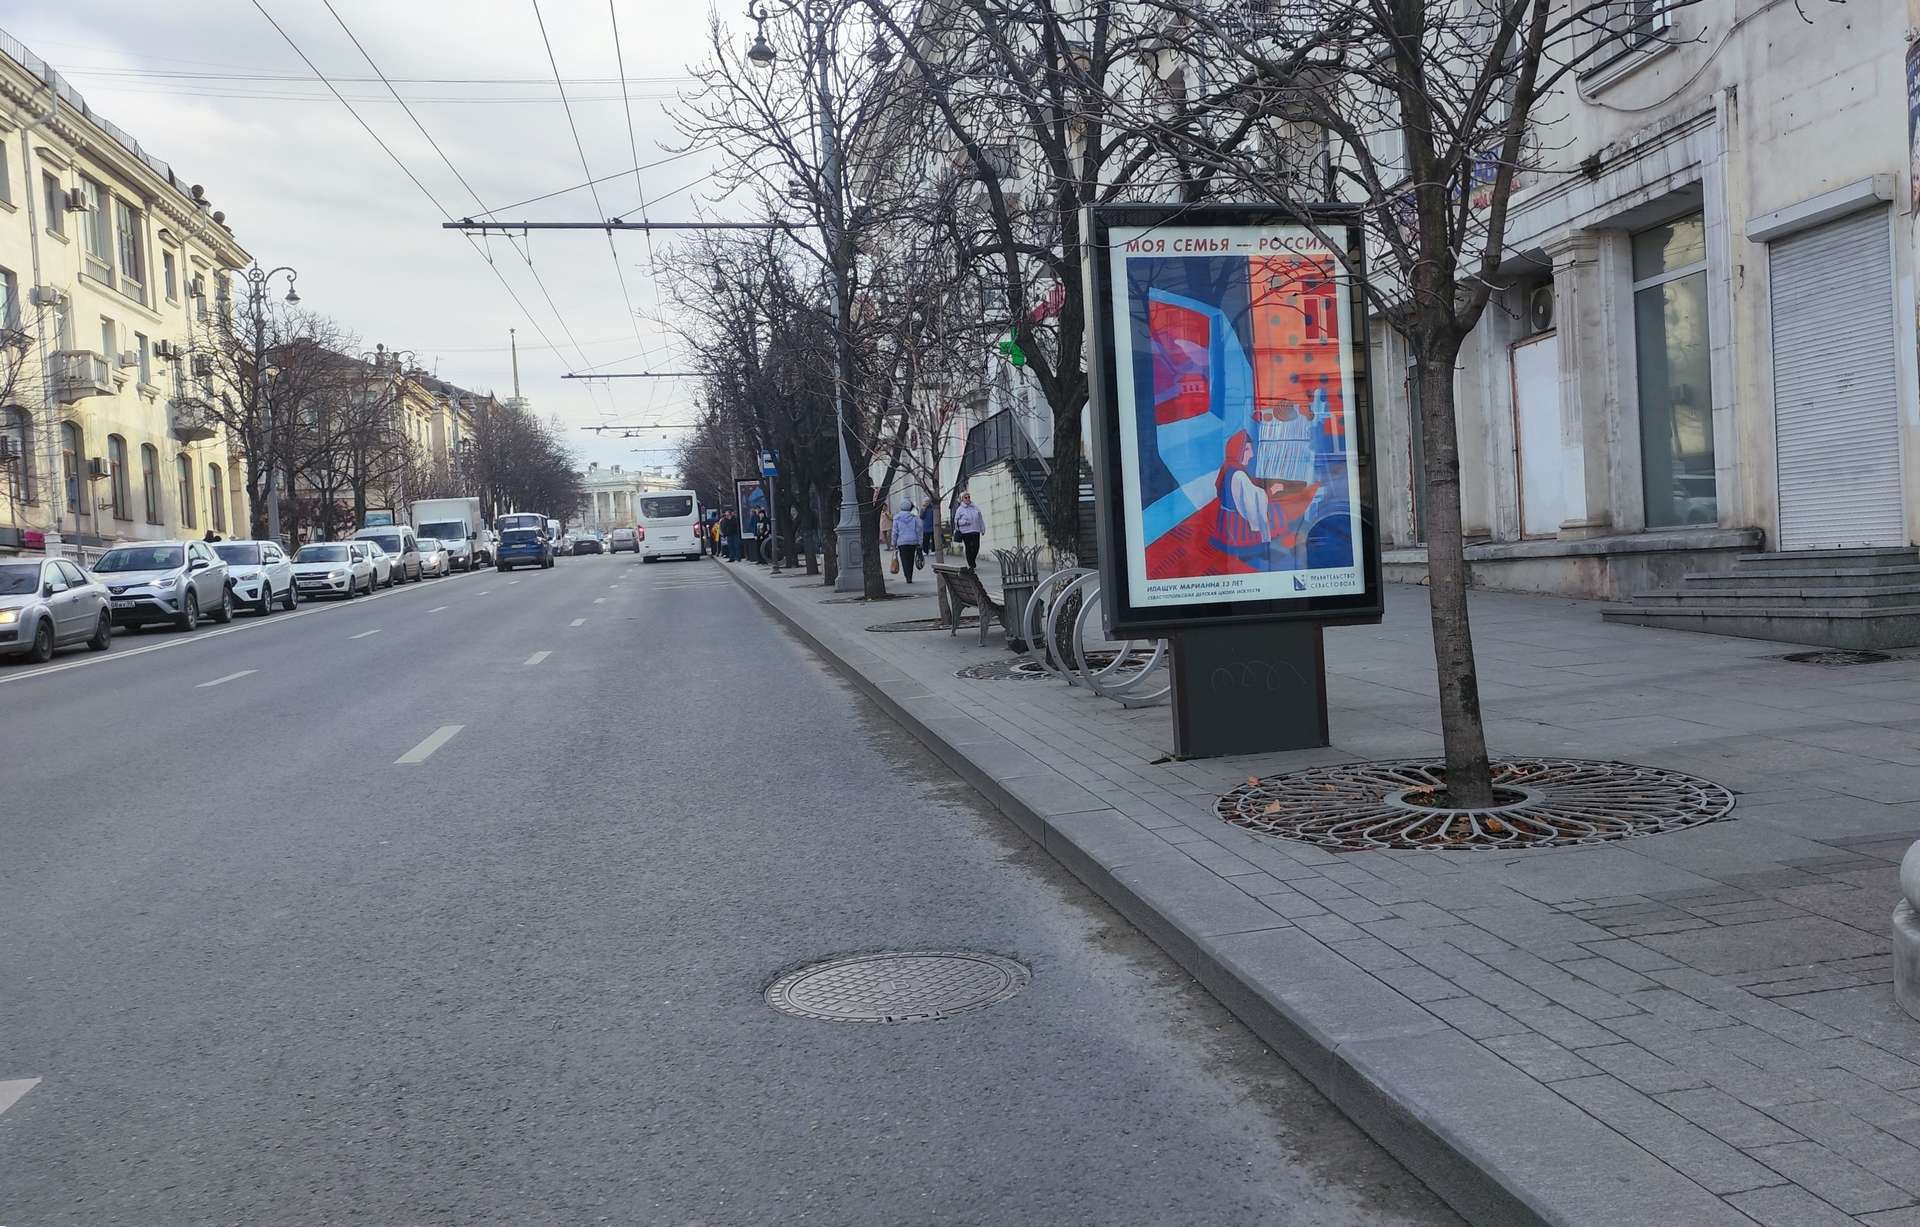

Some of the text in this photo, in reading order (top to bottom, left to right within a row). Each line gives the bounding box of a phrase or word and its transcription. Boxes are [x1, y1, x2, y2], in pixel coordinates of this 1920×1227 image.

[1126, 239, 1165, 253] МОЯ
[1173, 238, 1230, 252] СЕМЬЯ
[1179, 581, 1220, 590] МАРИАННА
